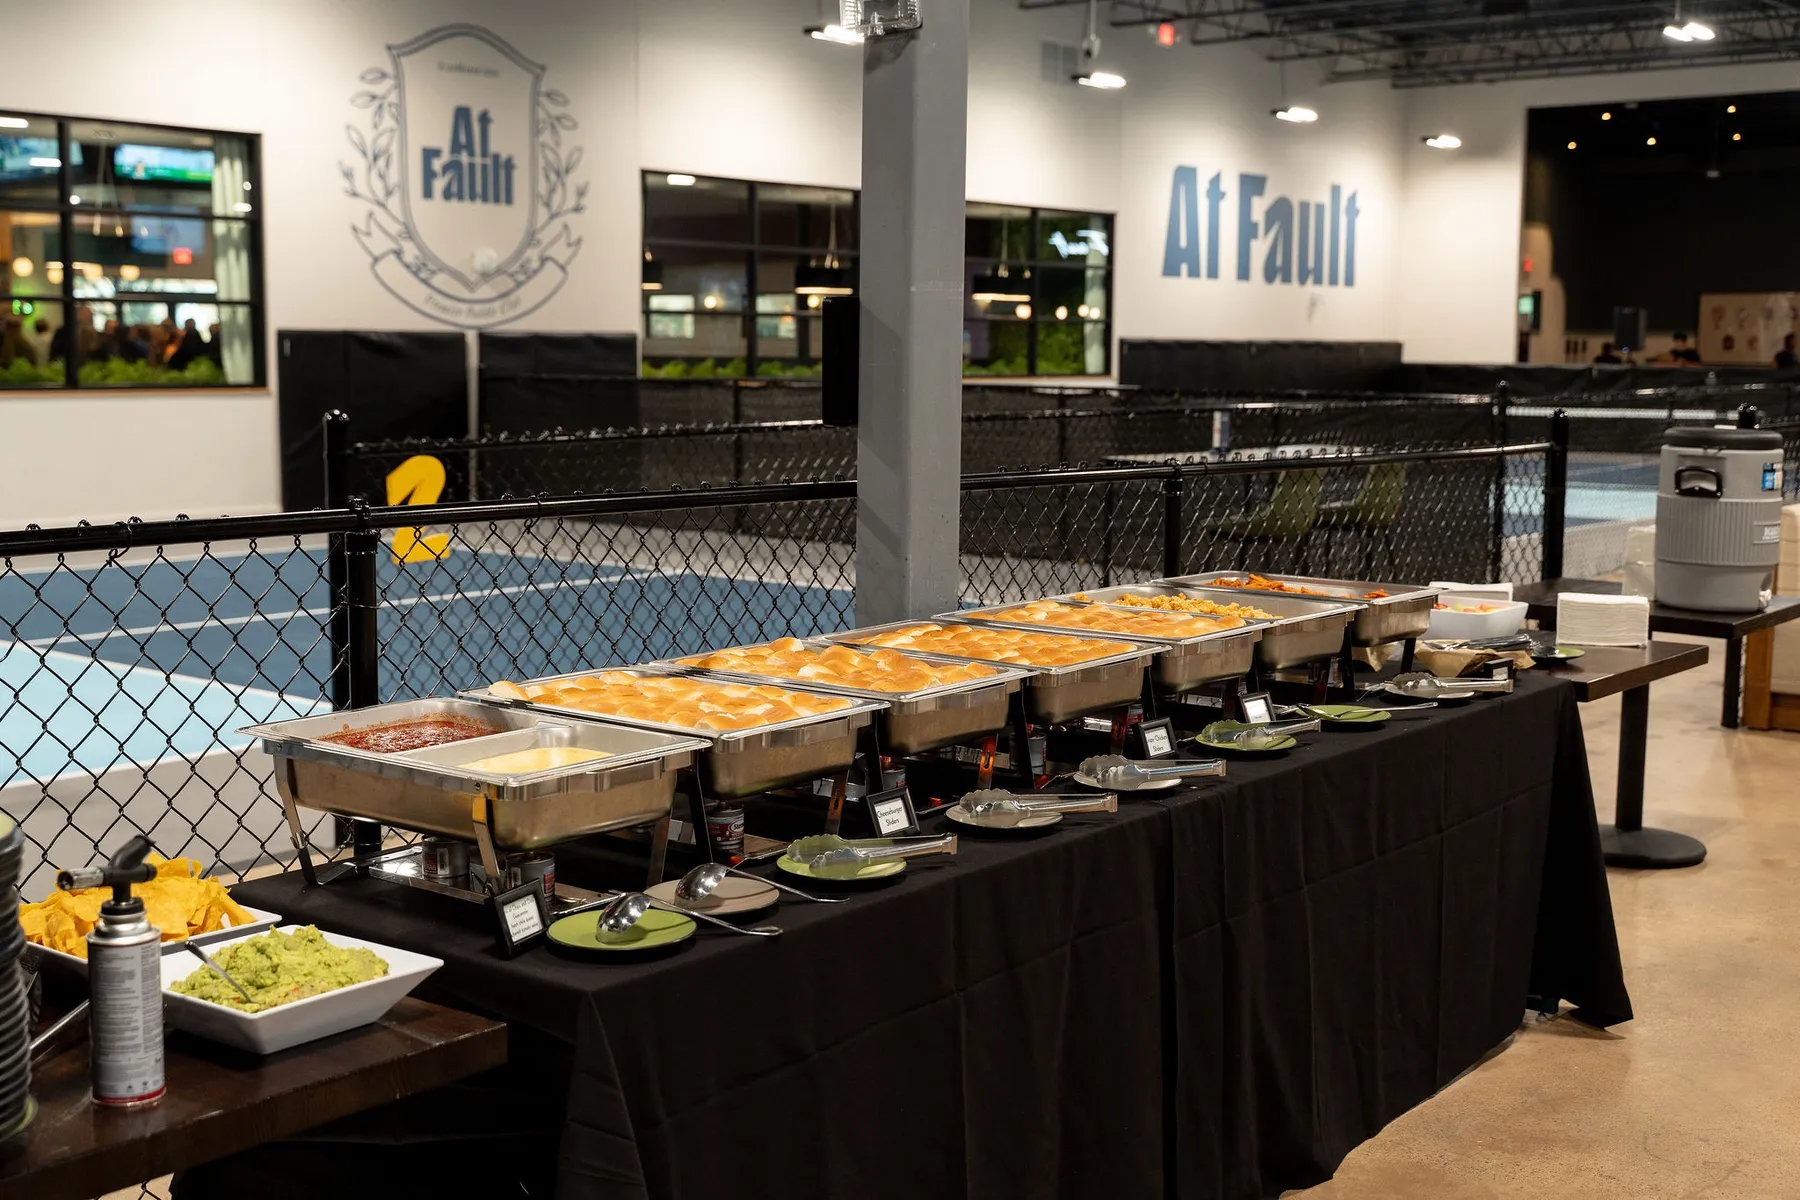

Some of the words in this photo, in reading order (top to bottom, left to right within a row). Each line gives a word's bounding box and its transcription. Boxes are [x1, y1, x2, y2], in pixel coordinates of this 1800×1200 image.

[450, 106, 493, 154] At
[422, 147, 515, 205] Fault
[1162, 164, 1227, 280] At
[1236, 172, 1361, 288] Fault
[876, 806, 903, 819] Cheeseburger
[885, 817, 900, 827] Sliders
